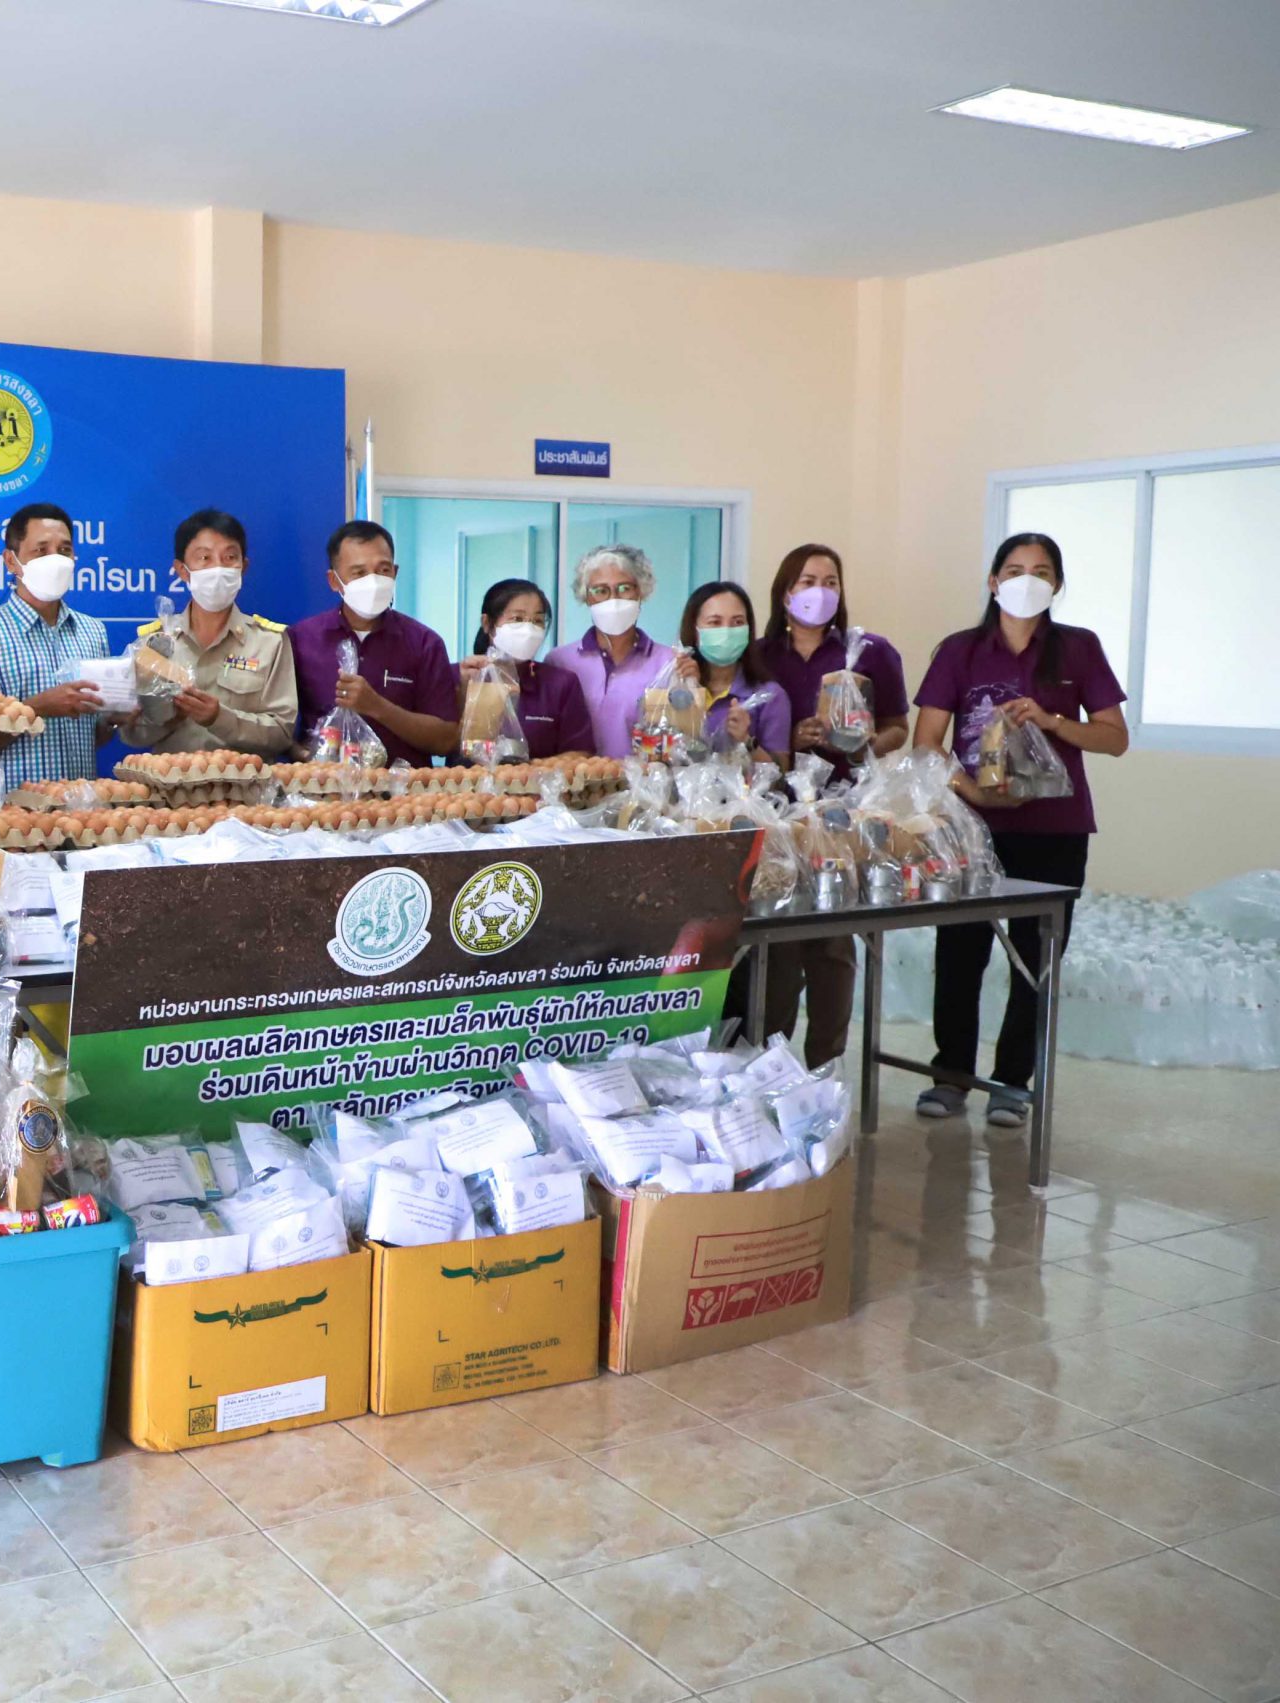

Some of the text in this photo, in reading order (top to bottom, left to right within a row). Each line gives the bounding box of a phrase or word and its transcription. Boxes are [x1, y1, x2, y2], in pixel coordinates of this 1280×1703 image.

[538, 450, 608, 466] ประชาสัมพันธ์
[139, 952, 701, 1020] หน่วยงานกระทรวงเกษตรและสหกรณ์จังหวัดสงขลา ร่วมกับ จังหวัดสงขลา
[144, 987, 702, 1069] มอบผลผลิตเกษตรและเมล็ดพันธุ์ผักให้คนสงขลา
[200, 1026, 648, 1101] ร่วมเดินหน้าข้ามผ่านวิกฤต COVID-19
[464, 1352, 486, 1361] STAR
[487, 1343, 529, 1358] AGRITECH
